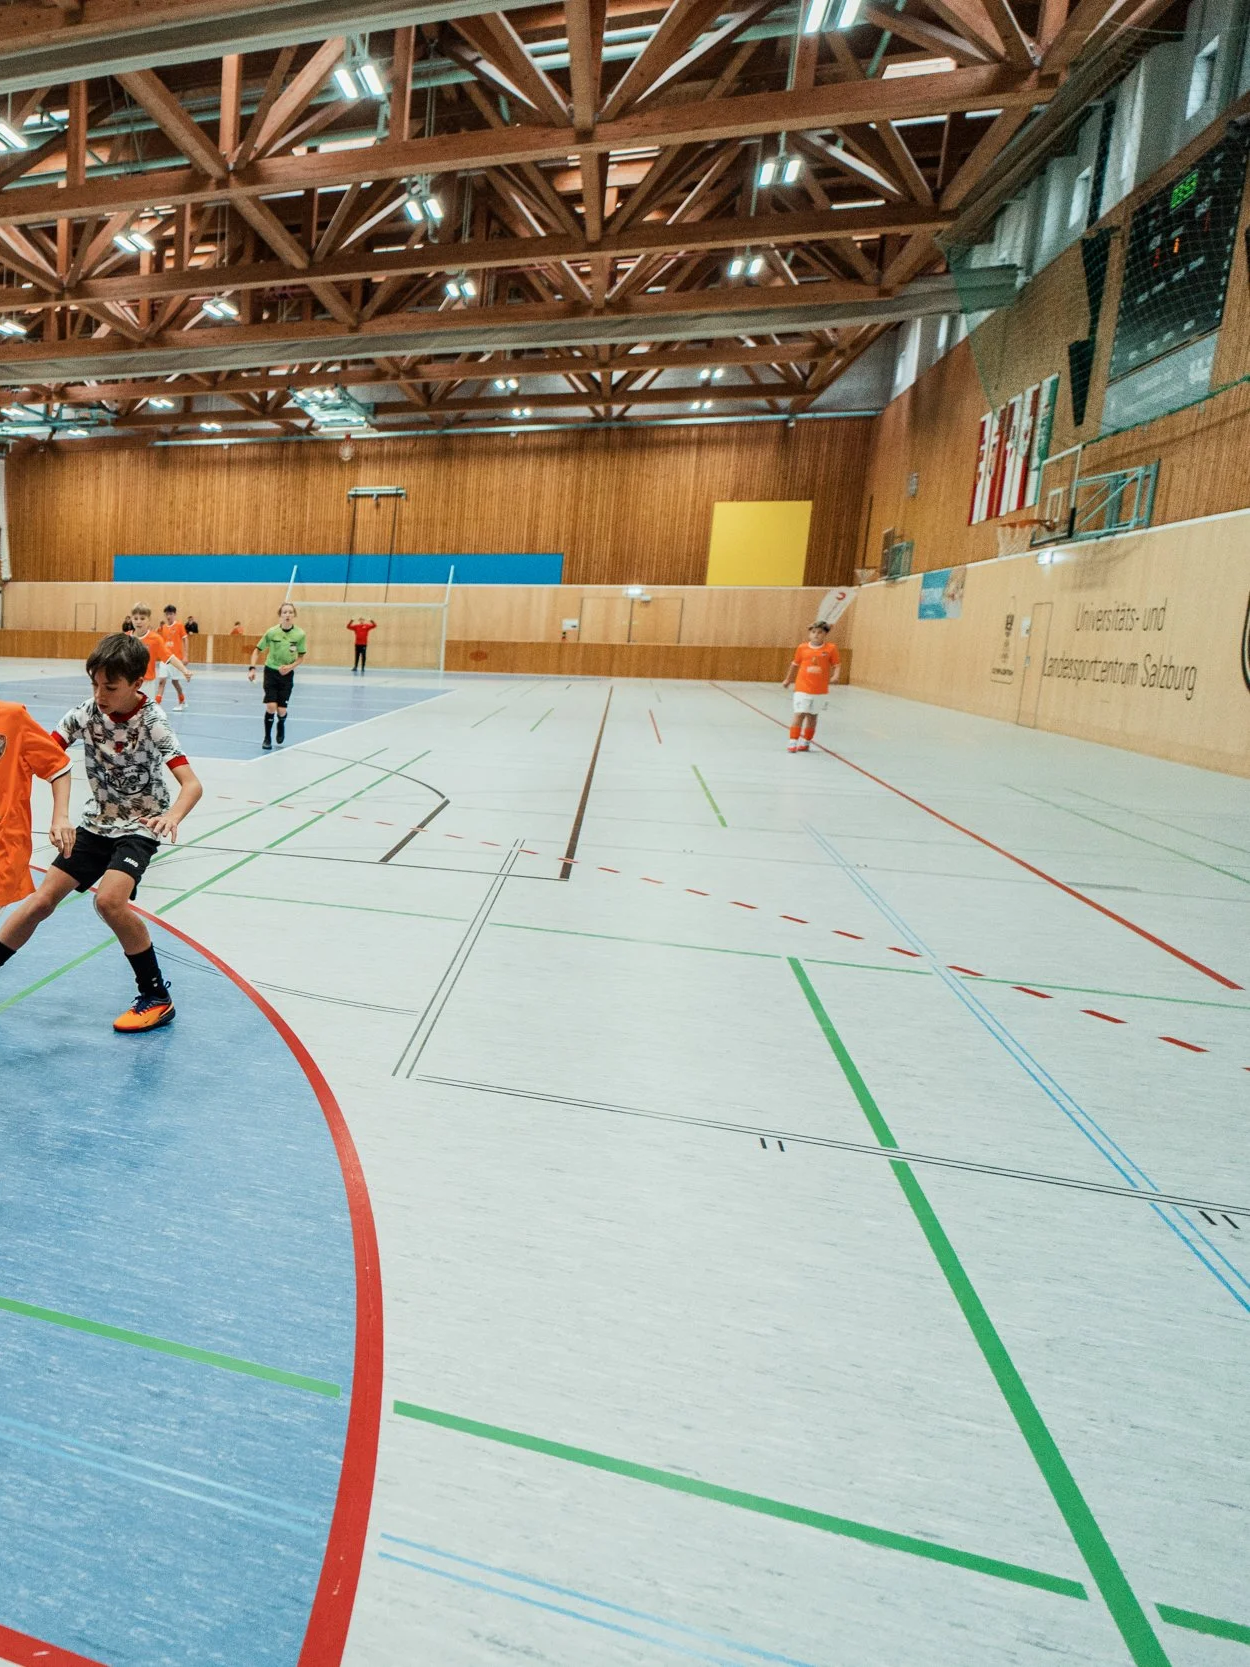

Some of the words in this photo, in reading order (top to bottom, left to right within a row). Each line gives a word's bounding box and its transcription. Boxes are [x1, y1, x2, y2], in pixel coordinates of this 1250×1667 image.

[1075, 600, 1140, 632] Universitäts-
[1142, 597, 1168, 631] und
[1141, 653, 1198, 701] Salzburg
